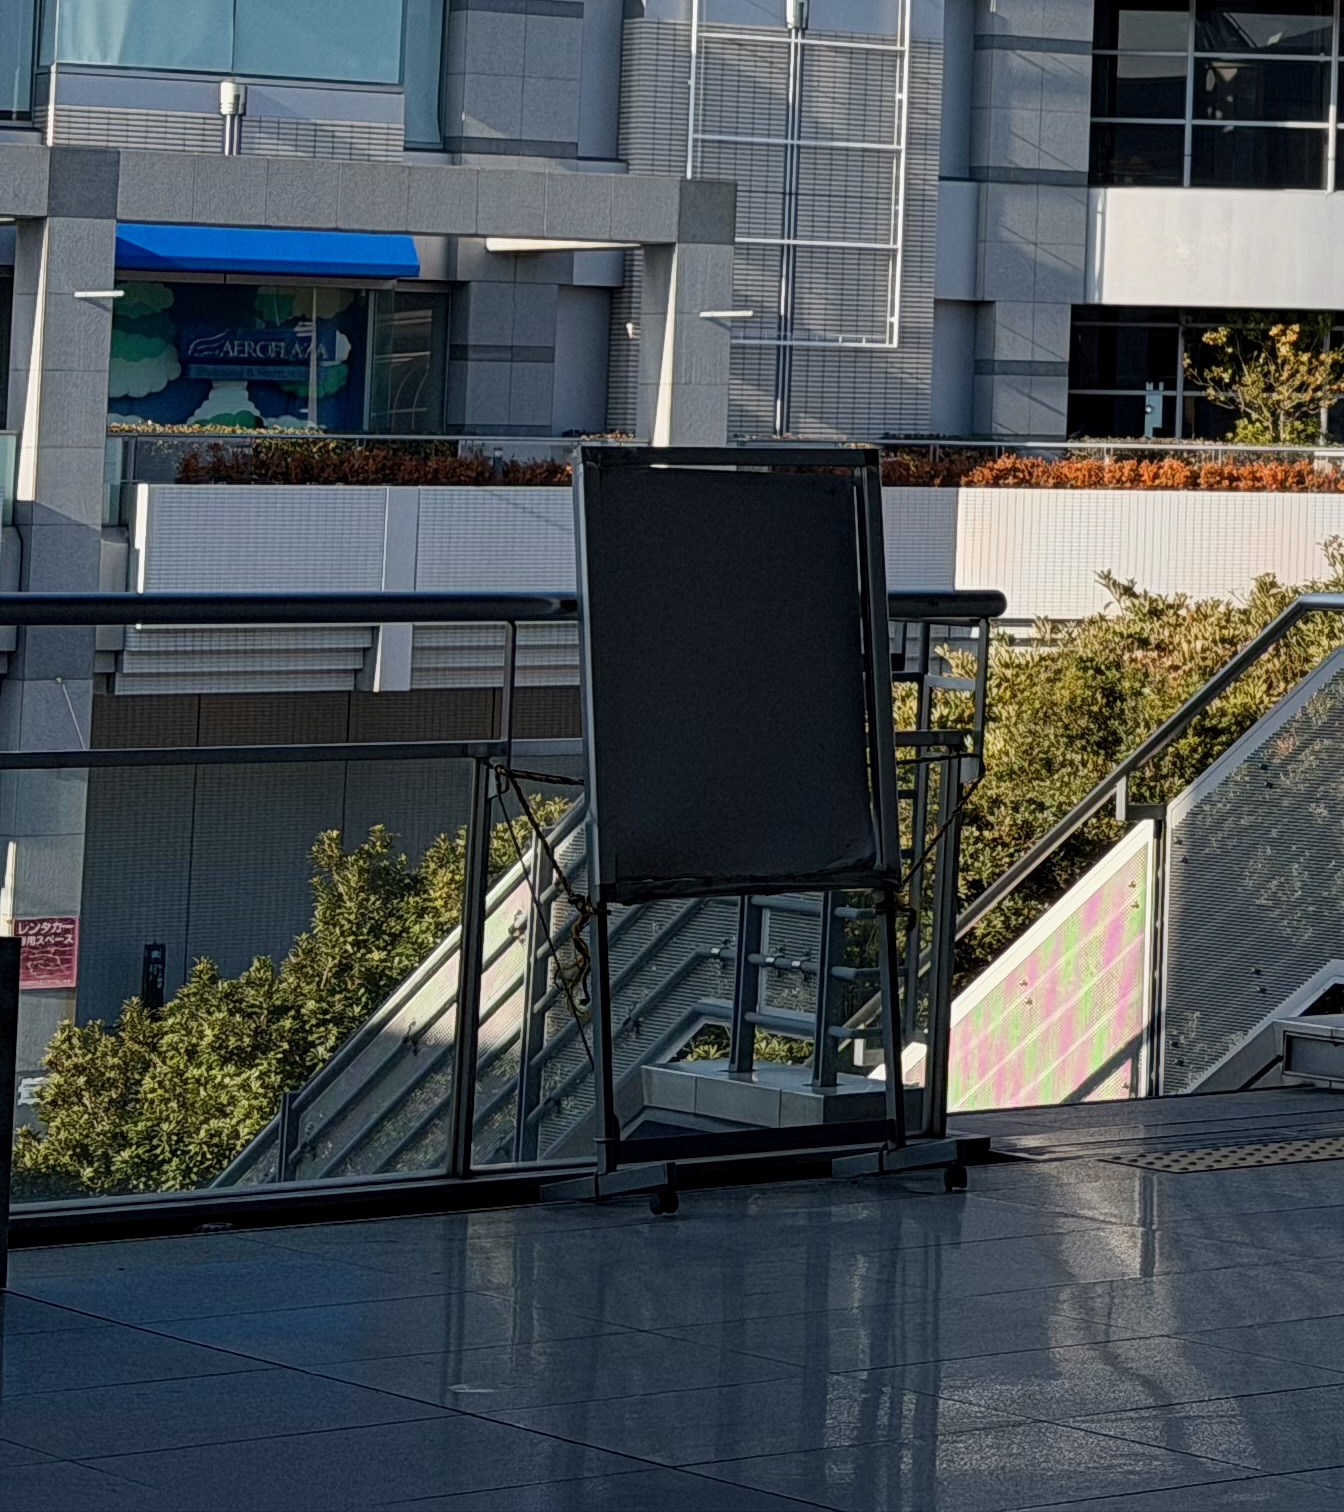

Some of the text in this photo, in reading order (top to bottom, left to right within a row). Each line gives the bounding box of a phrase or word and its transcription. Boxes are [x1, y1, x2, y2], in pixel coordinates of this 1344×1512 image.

[17, 921, 75, 935] レンタカー
